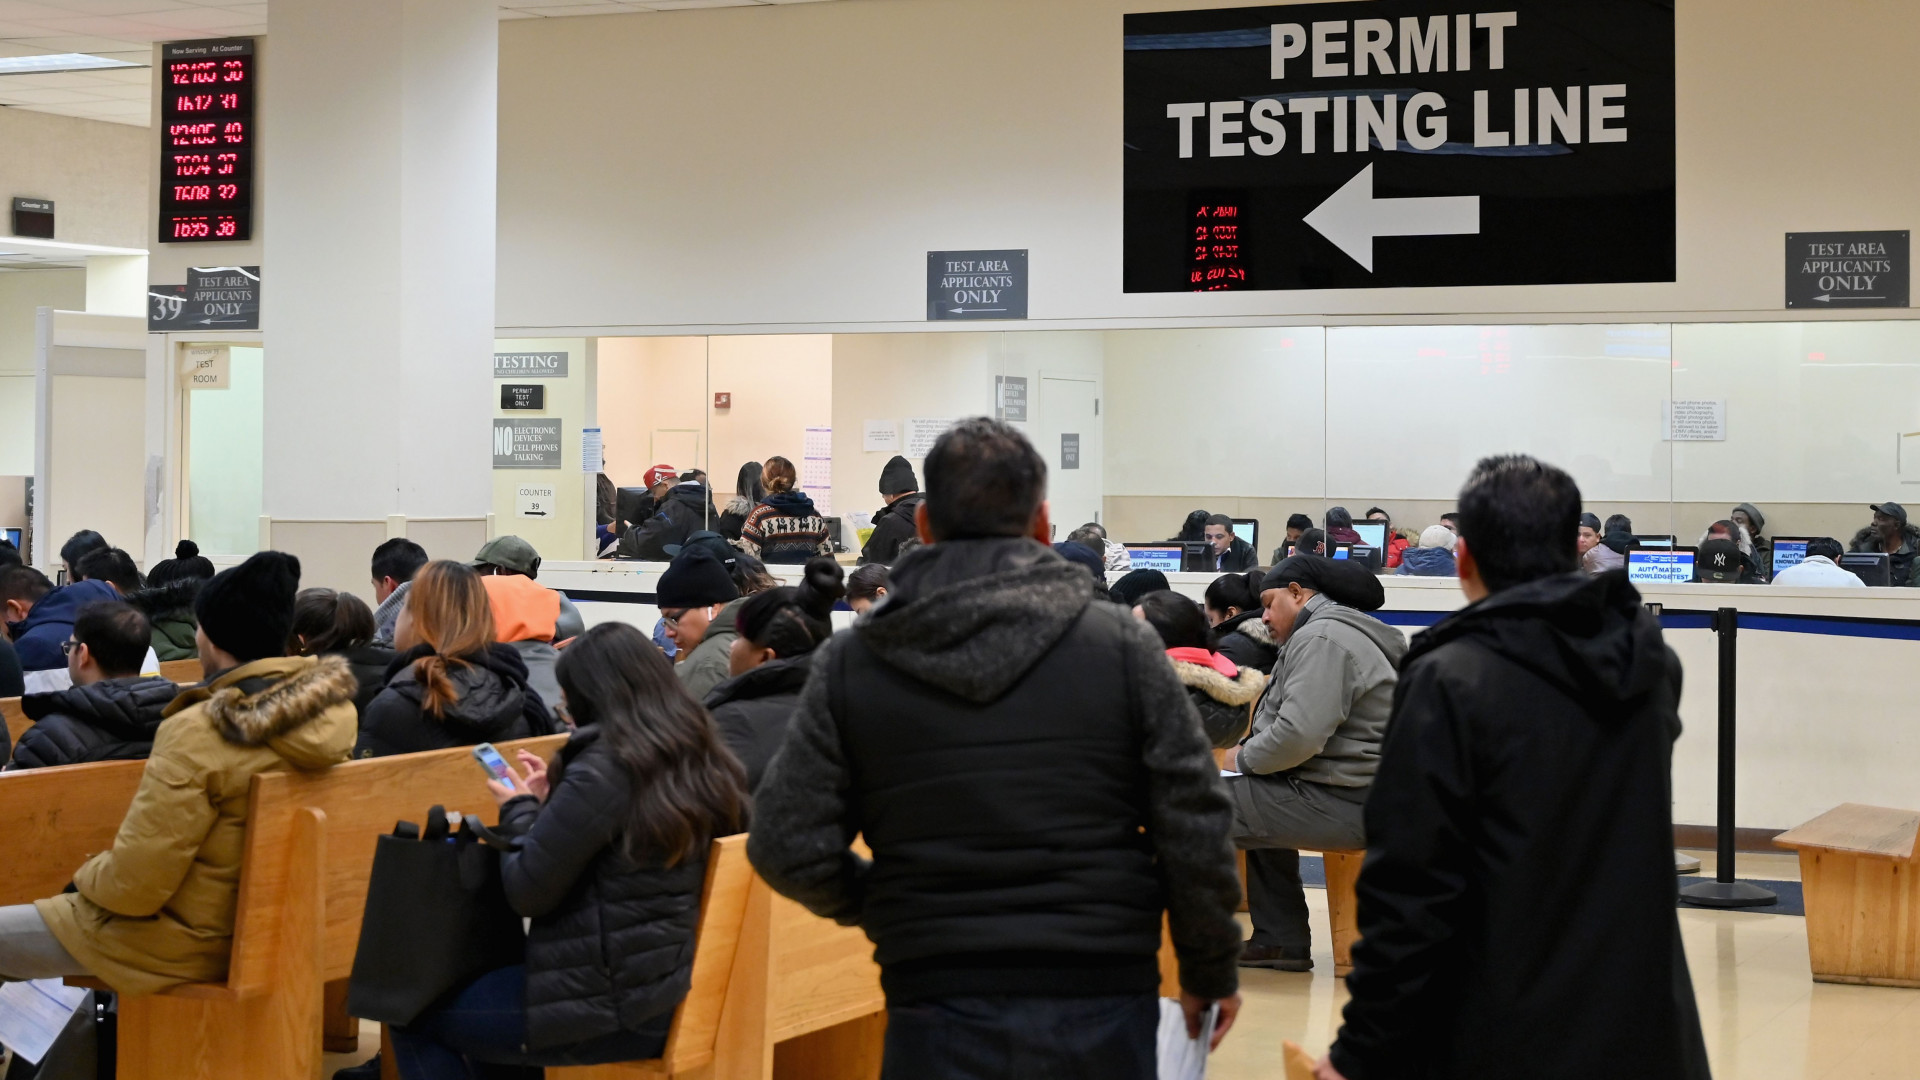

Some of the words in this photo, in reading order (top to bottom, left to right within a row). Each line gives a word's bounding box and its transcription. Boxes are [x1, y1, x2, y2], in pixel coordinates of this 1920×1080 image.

[1270, 11, 1518, 80] PERMIT
[1167, 91, 1448, 159] TESTING
[1473, 84, 1628, 148] LINE
[21, 201, 41, 209] Counter
[1808, 243, 1845, 256] TEST
[1847, 242, 1886, 255] AREA
[945, 261, 975, 272] TEST
[977, 260, 1009, 272] AREA
[1801, 260, 1891, 273] APPLICANTS
[198, 277, 221, 287] TEST
[223, 276, 249, 287] AREA
[940, 275, 1013, 288] APPLICANTS
[1818, 275, 1877, 291] ONLY
[193, 290, 252, 301] APPLICANTS
[954, 290, 1002, 304] ONLY
[152, 295, 183, 321] 39
[204, 302, 243, 316] ONLY
[196, 360, 214, 369] TEST
[494, 355, 558, 369] TESTING
[193, 375, 217, 383] ROOM
[514, 426, 556, 435] ELECTRONIC
[494, 426, 513, 456] NO
[519, 489, 552, 497] COUNTER
[531, 502, 540, 510] 39
